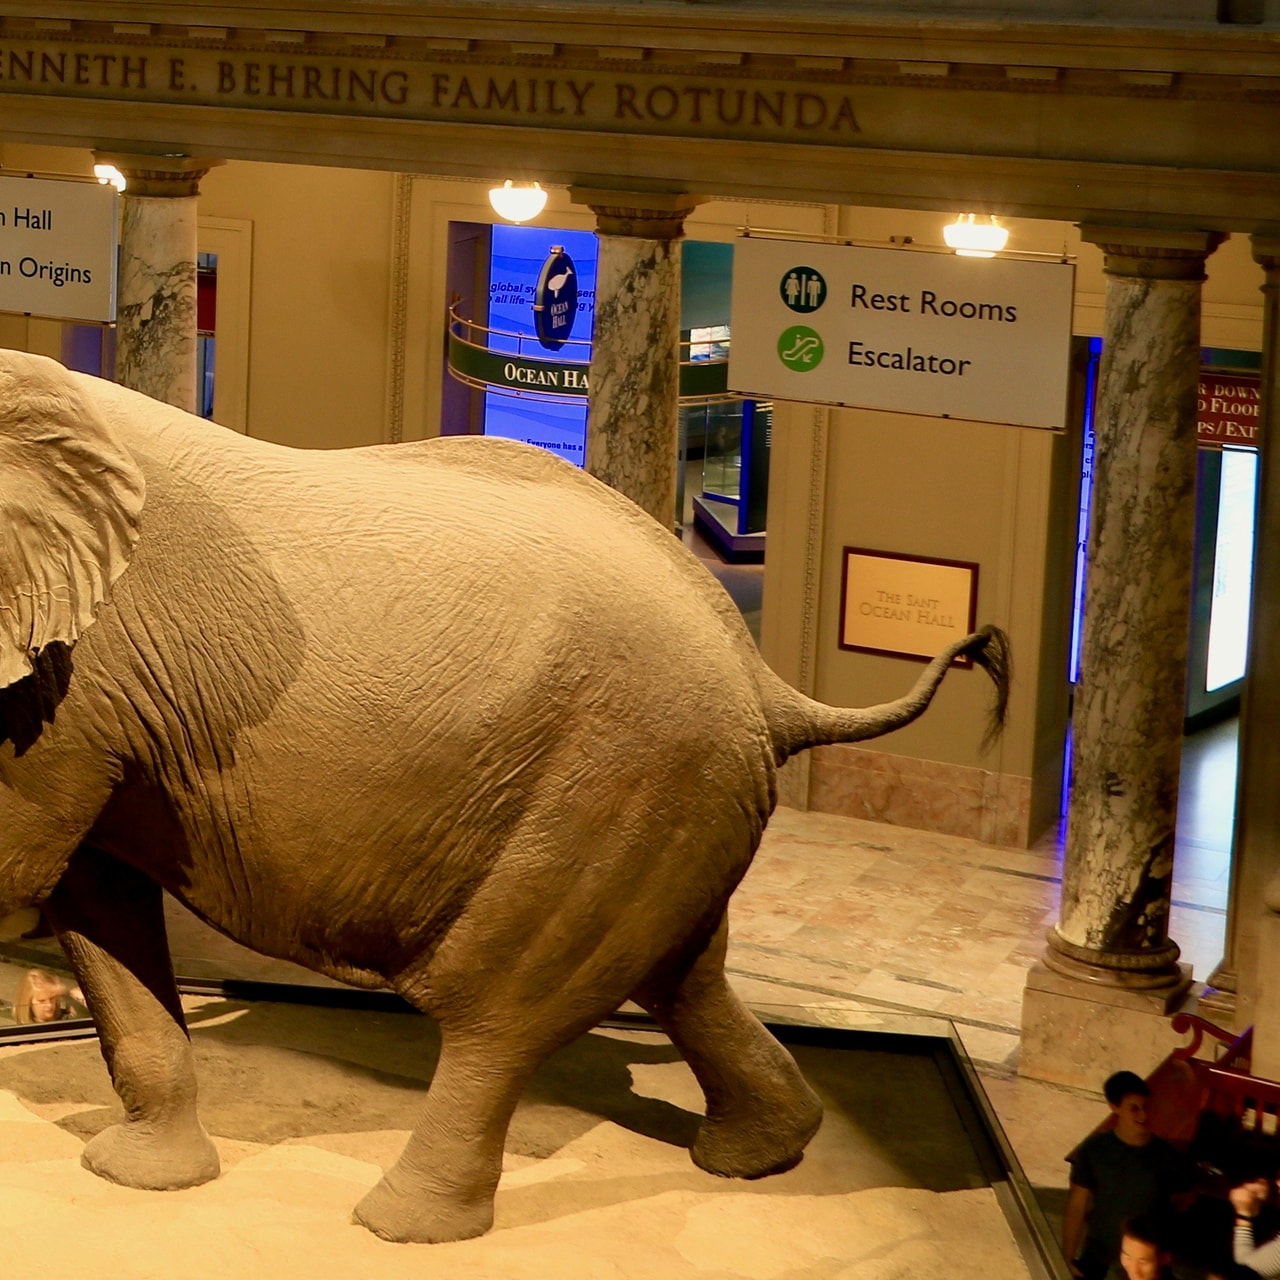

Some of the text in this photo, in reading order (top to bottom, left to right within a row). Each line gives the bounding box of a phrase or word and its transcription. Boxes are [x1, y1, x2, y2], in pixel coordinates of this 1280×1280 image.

[168, 58, 197, 91] E.
[217, 60, 409, 105] BEHRING
[431, 73, 595, 116] FAMILY
[614, 83, 863, 133] ROTUNDA
[13, 204, 53, 232] Hall
[18, 255, 92, 289] Origins
[490, 282, 524, 294] global
[494, 294, 508, 304] all
[850, 283, 1018, 323] Rest Rooms
[847, 341, 971, 378] Escalator
[504, 362, 589, 389] OCEAN HA
[876, 590, 941, 610] THE SANT
[859, 601, 955, 628] OCEAN HALL
